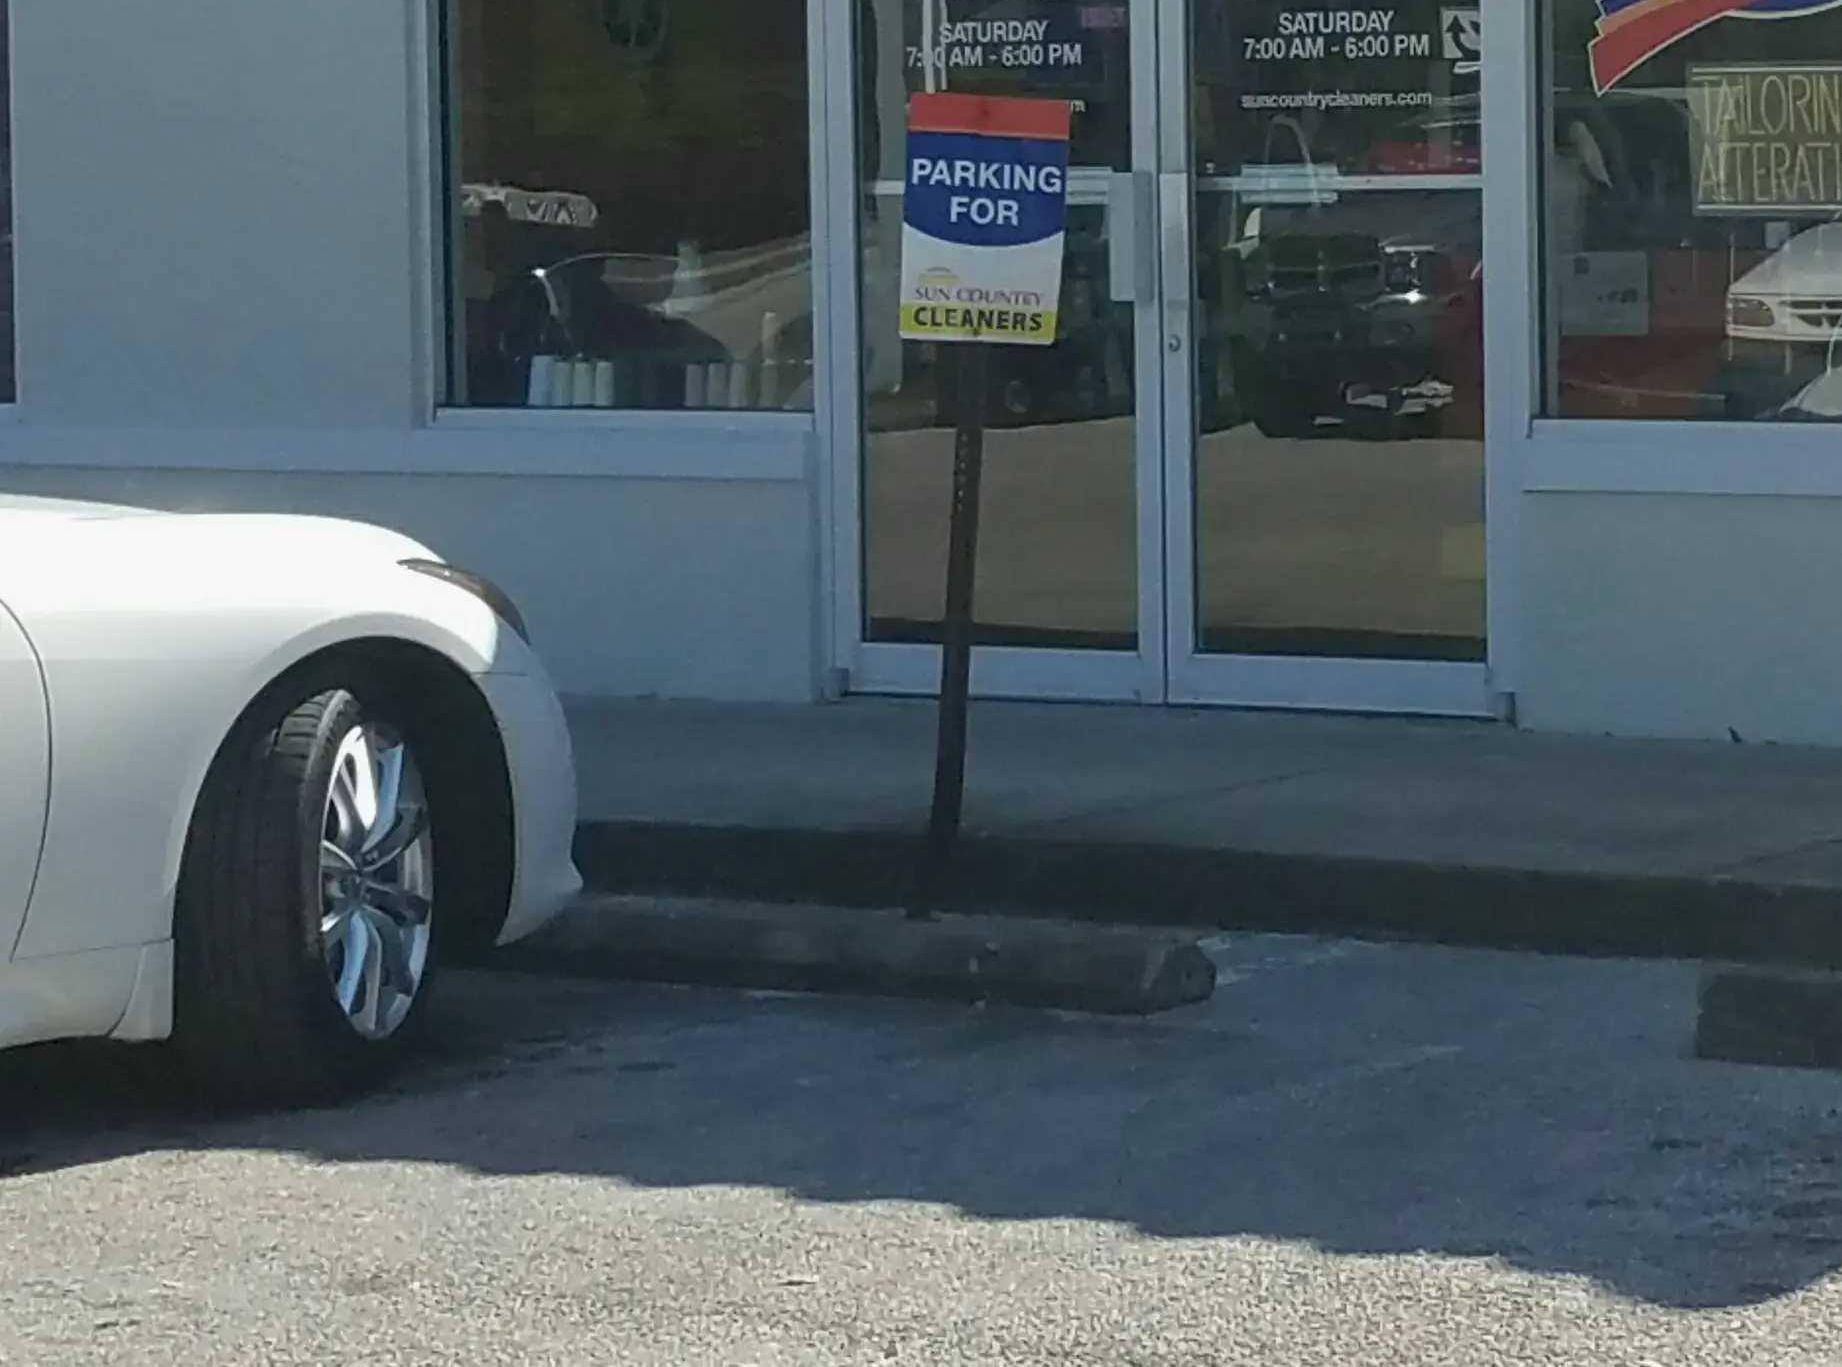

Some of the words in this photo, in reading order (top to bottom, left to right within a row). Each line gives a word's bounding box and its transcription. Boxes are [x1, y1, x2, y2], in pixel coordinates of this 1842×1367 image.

[939, 20, 1049, 43] SATURDAY
[1278, 11, 1395, 35] SATURDAY
[949, 45, 983, 67] AM
[1002, 44, 1044, 67] 6:00
[1050, 43, 1082, 65] PM
[1243, 38, 1286, 60] 7:00
[1289, 37, 1325, 59] AM
[1345, 35, 1389, 58] 6:00
[1395, 34, 1430, 57] PM
[1241, 90, 1432, 111] suncountrycleaners.com
[911, 158, 1063, 194] PARKING
[949, 195, 1020, 226] FOR
[914, 286, 951, 302] SUN
[956, 287, 1044, 307] COUNTRY
[912, 306, 1043, 332] CLEANERS
